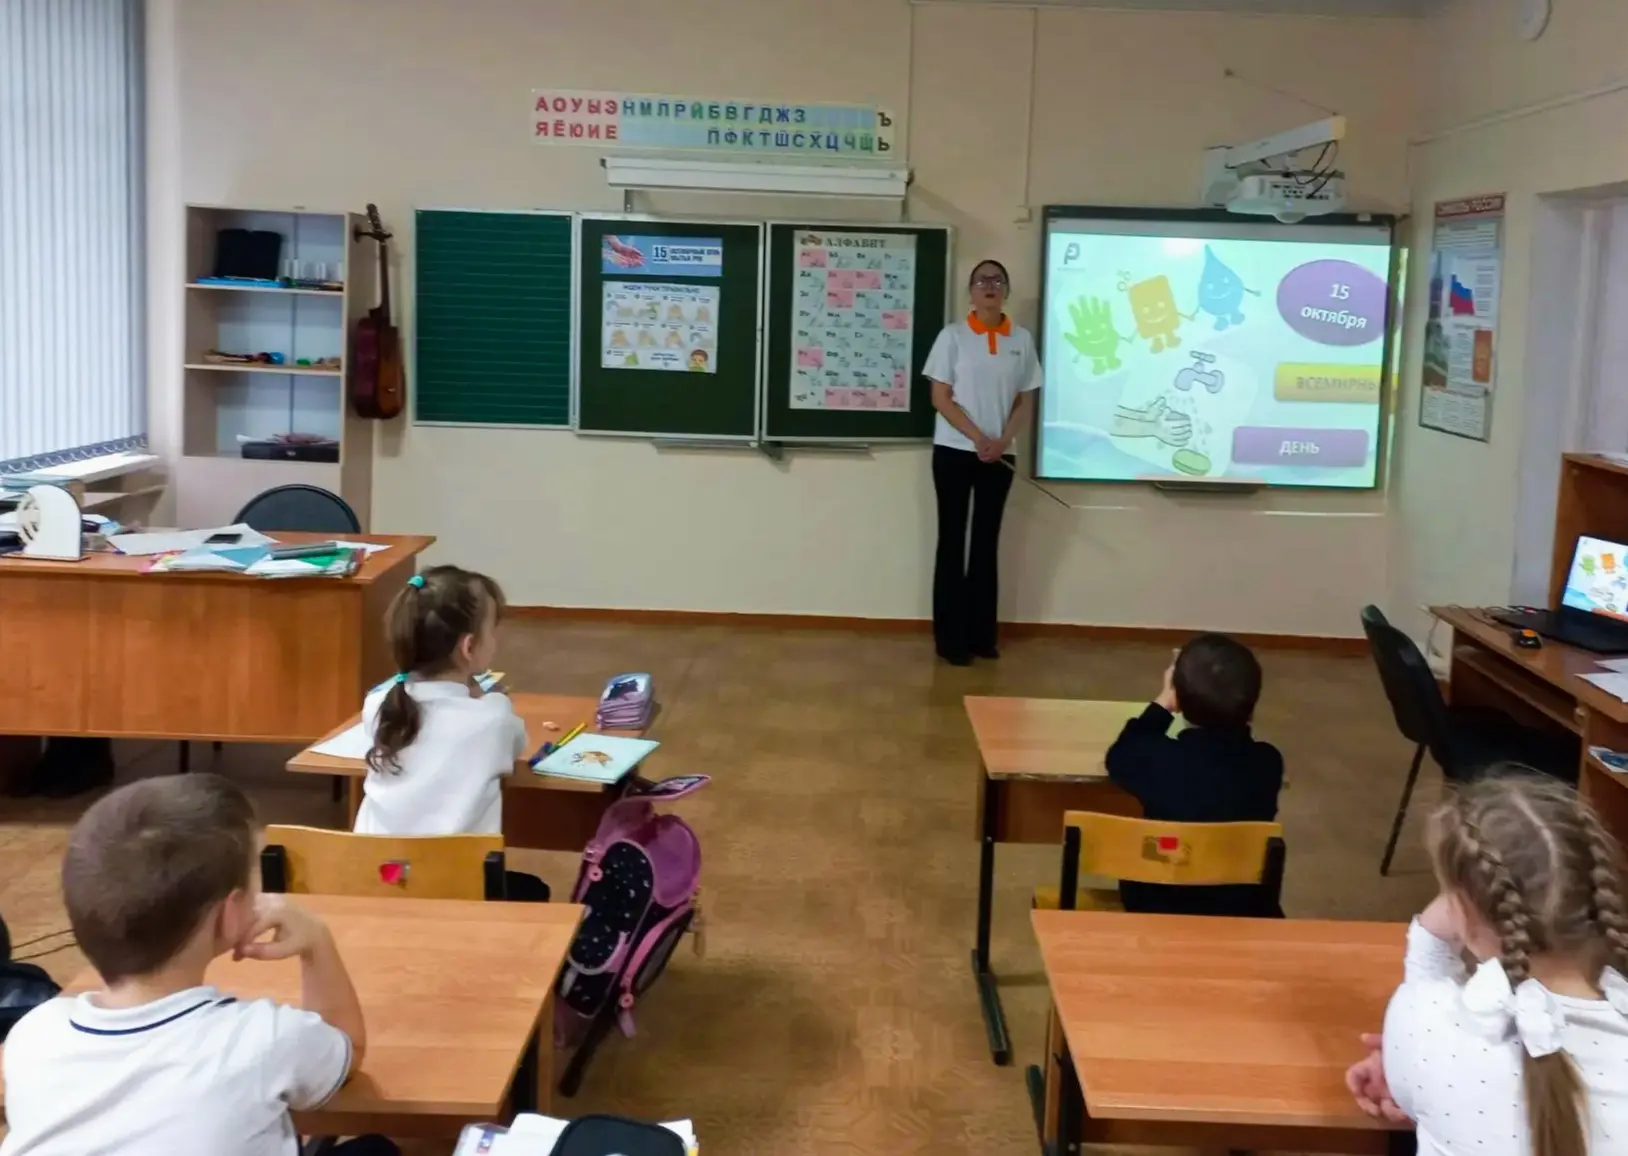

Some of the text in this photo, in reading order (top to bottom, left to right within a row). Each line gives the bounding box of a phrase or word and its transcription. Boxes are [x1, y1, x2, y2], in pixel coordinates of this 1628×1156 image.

[653, 246, 668, 258] 15
[1329, 283, 1350, 300] 15
[1300, 306, 1368, 329] октября
[1278, 440, 1320, 455] ДЕНЬ
